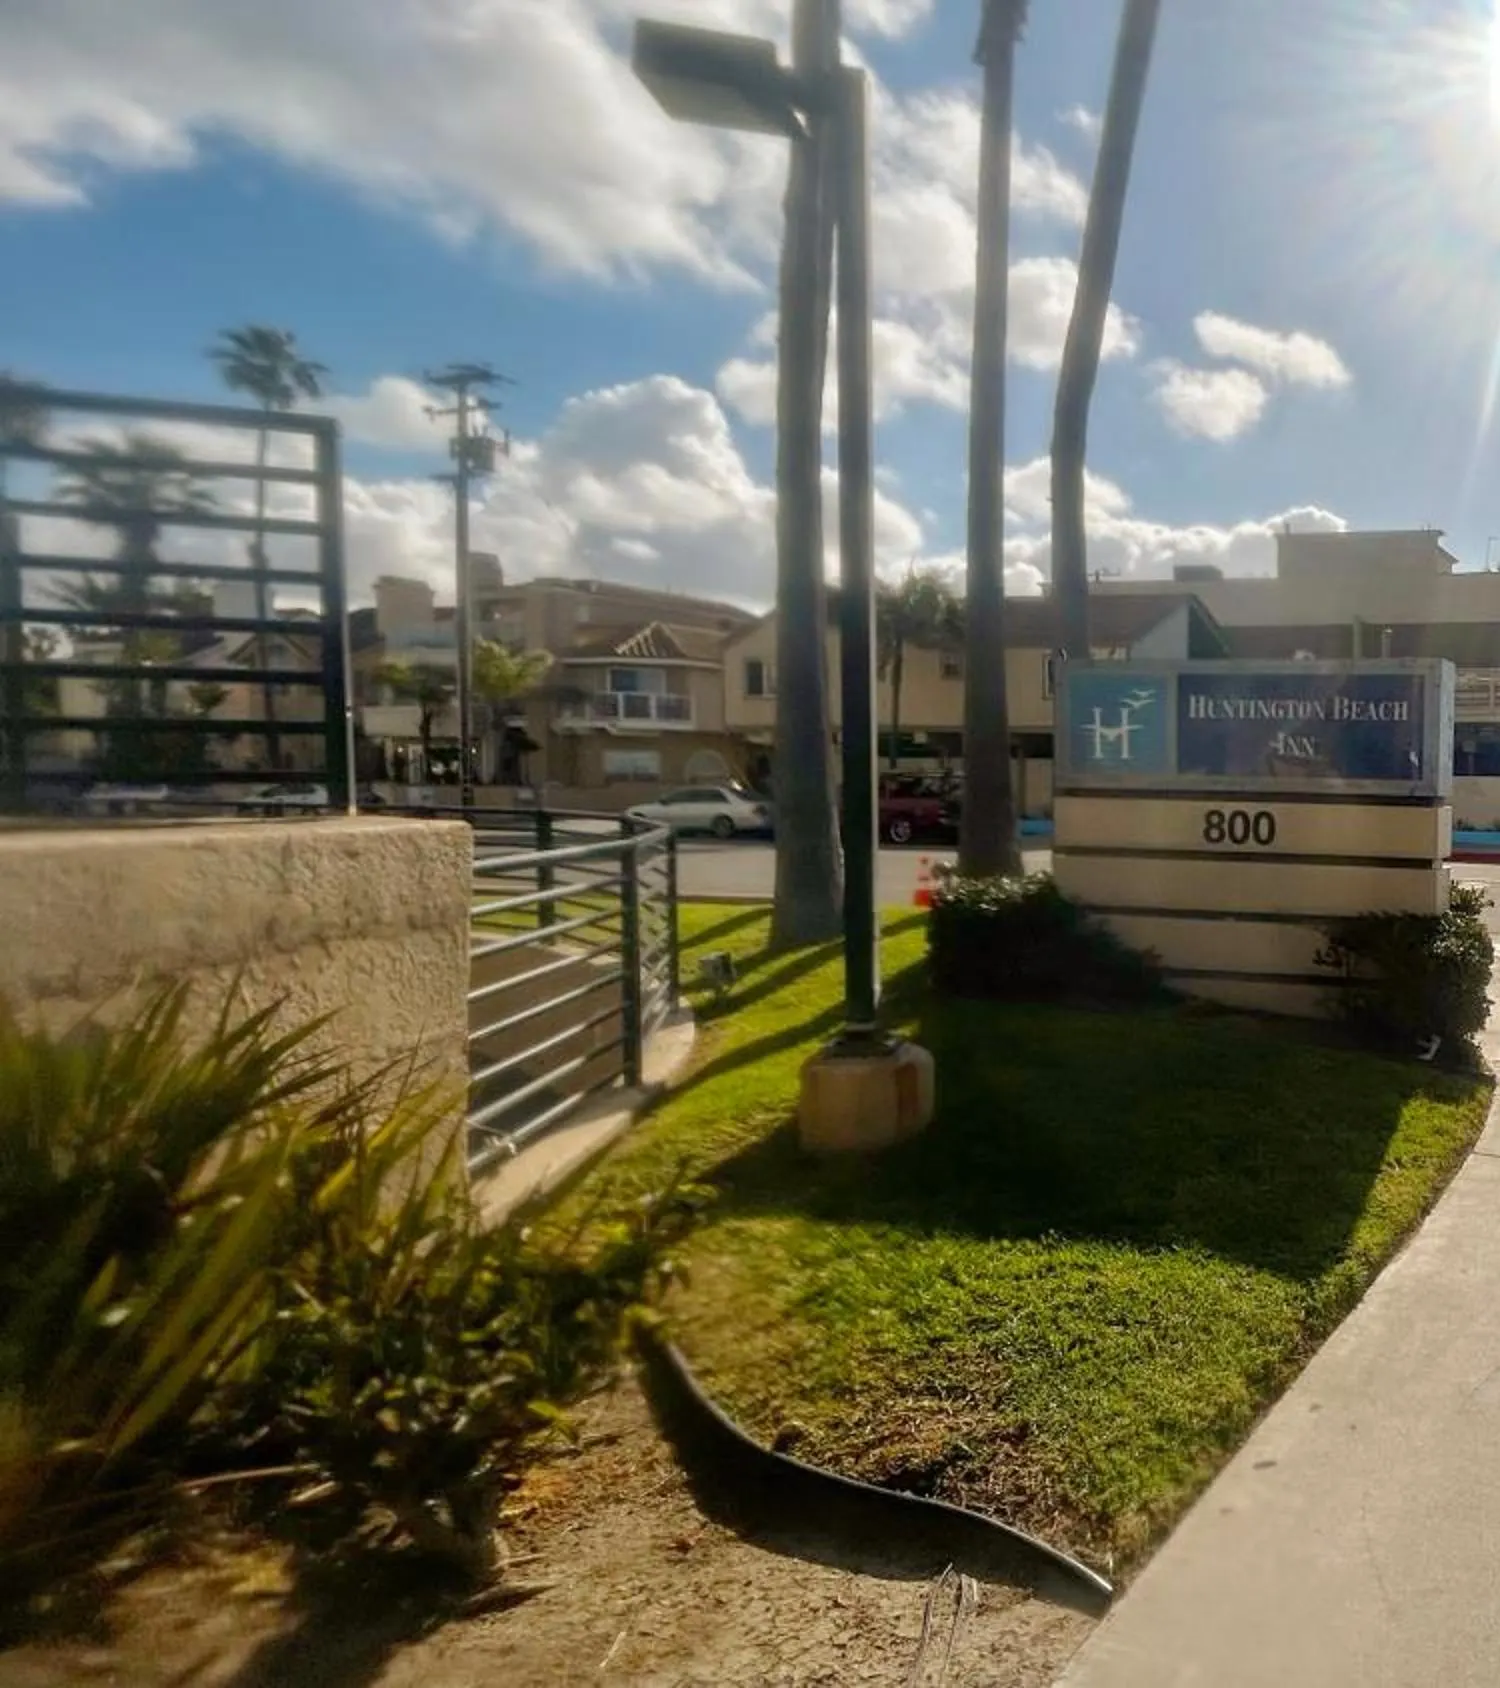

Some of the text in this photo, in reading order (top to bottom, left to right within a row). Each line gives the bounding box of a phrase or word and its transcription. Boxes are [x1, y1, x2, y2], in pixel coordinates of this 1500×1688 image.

[1188, 694, 1408, 722] HUNTINGTON BEACH
[1275, 732, 1315, 757] INN
[1203, 809, 1276, 846] 800
